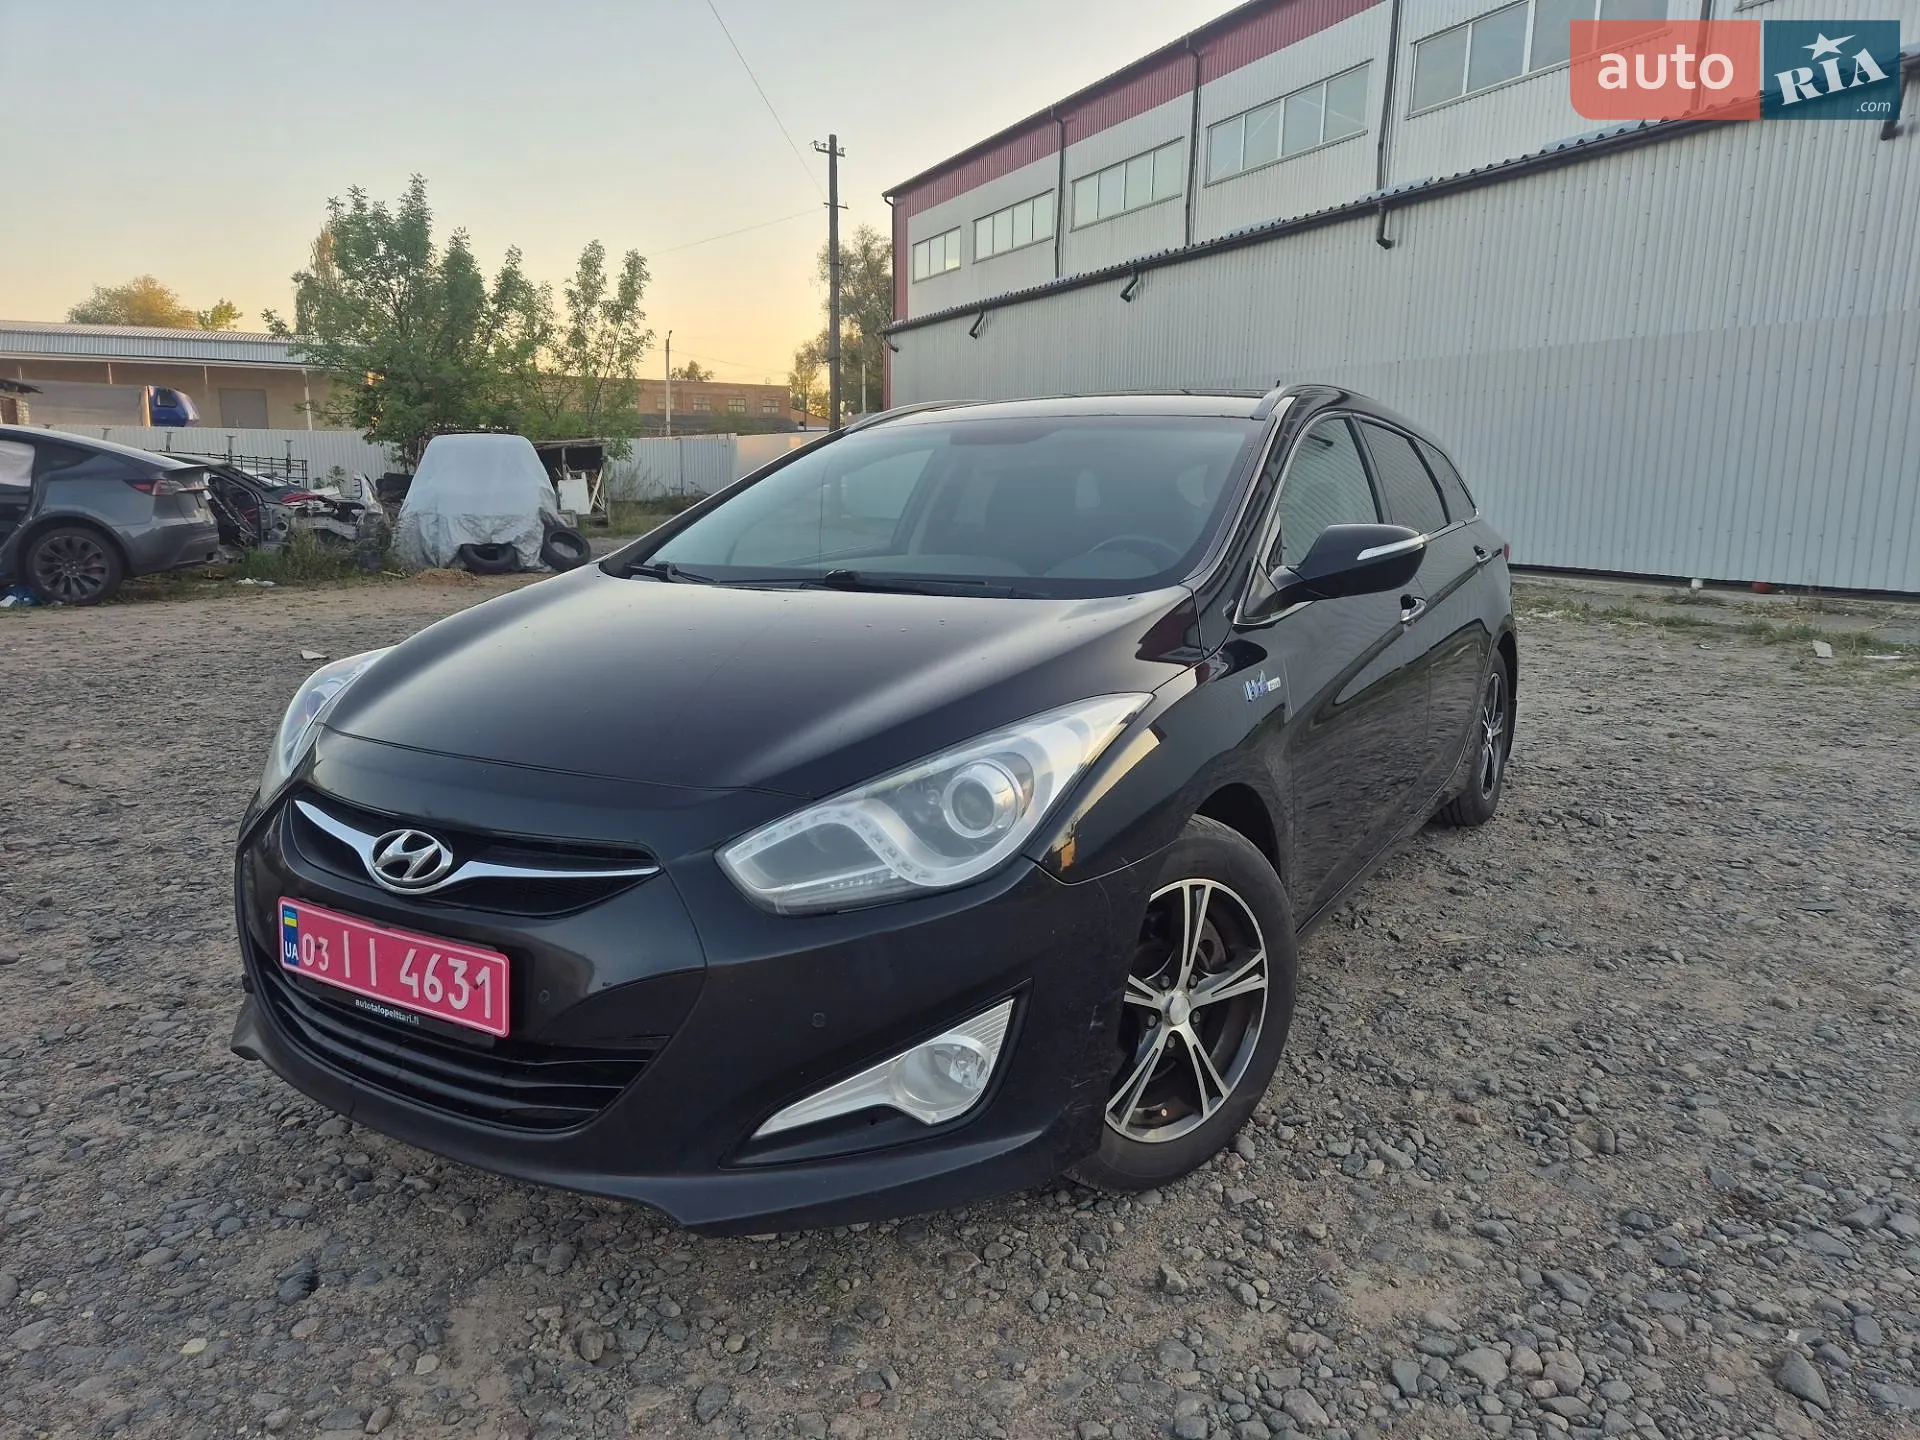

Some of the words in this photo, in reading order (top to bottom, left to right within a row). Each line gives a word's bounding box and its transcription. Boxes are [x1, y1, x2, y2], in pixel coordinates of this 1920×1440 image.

[285, 940, 299, 960] UA
[302, 932, 329, 972] 03
[400, 948, 491, 1019] 4631
